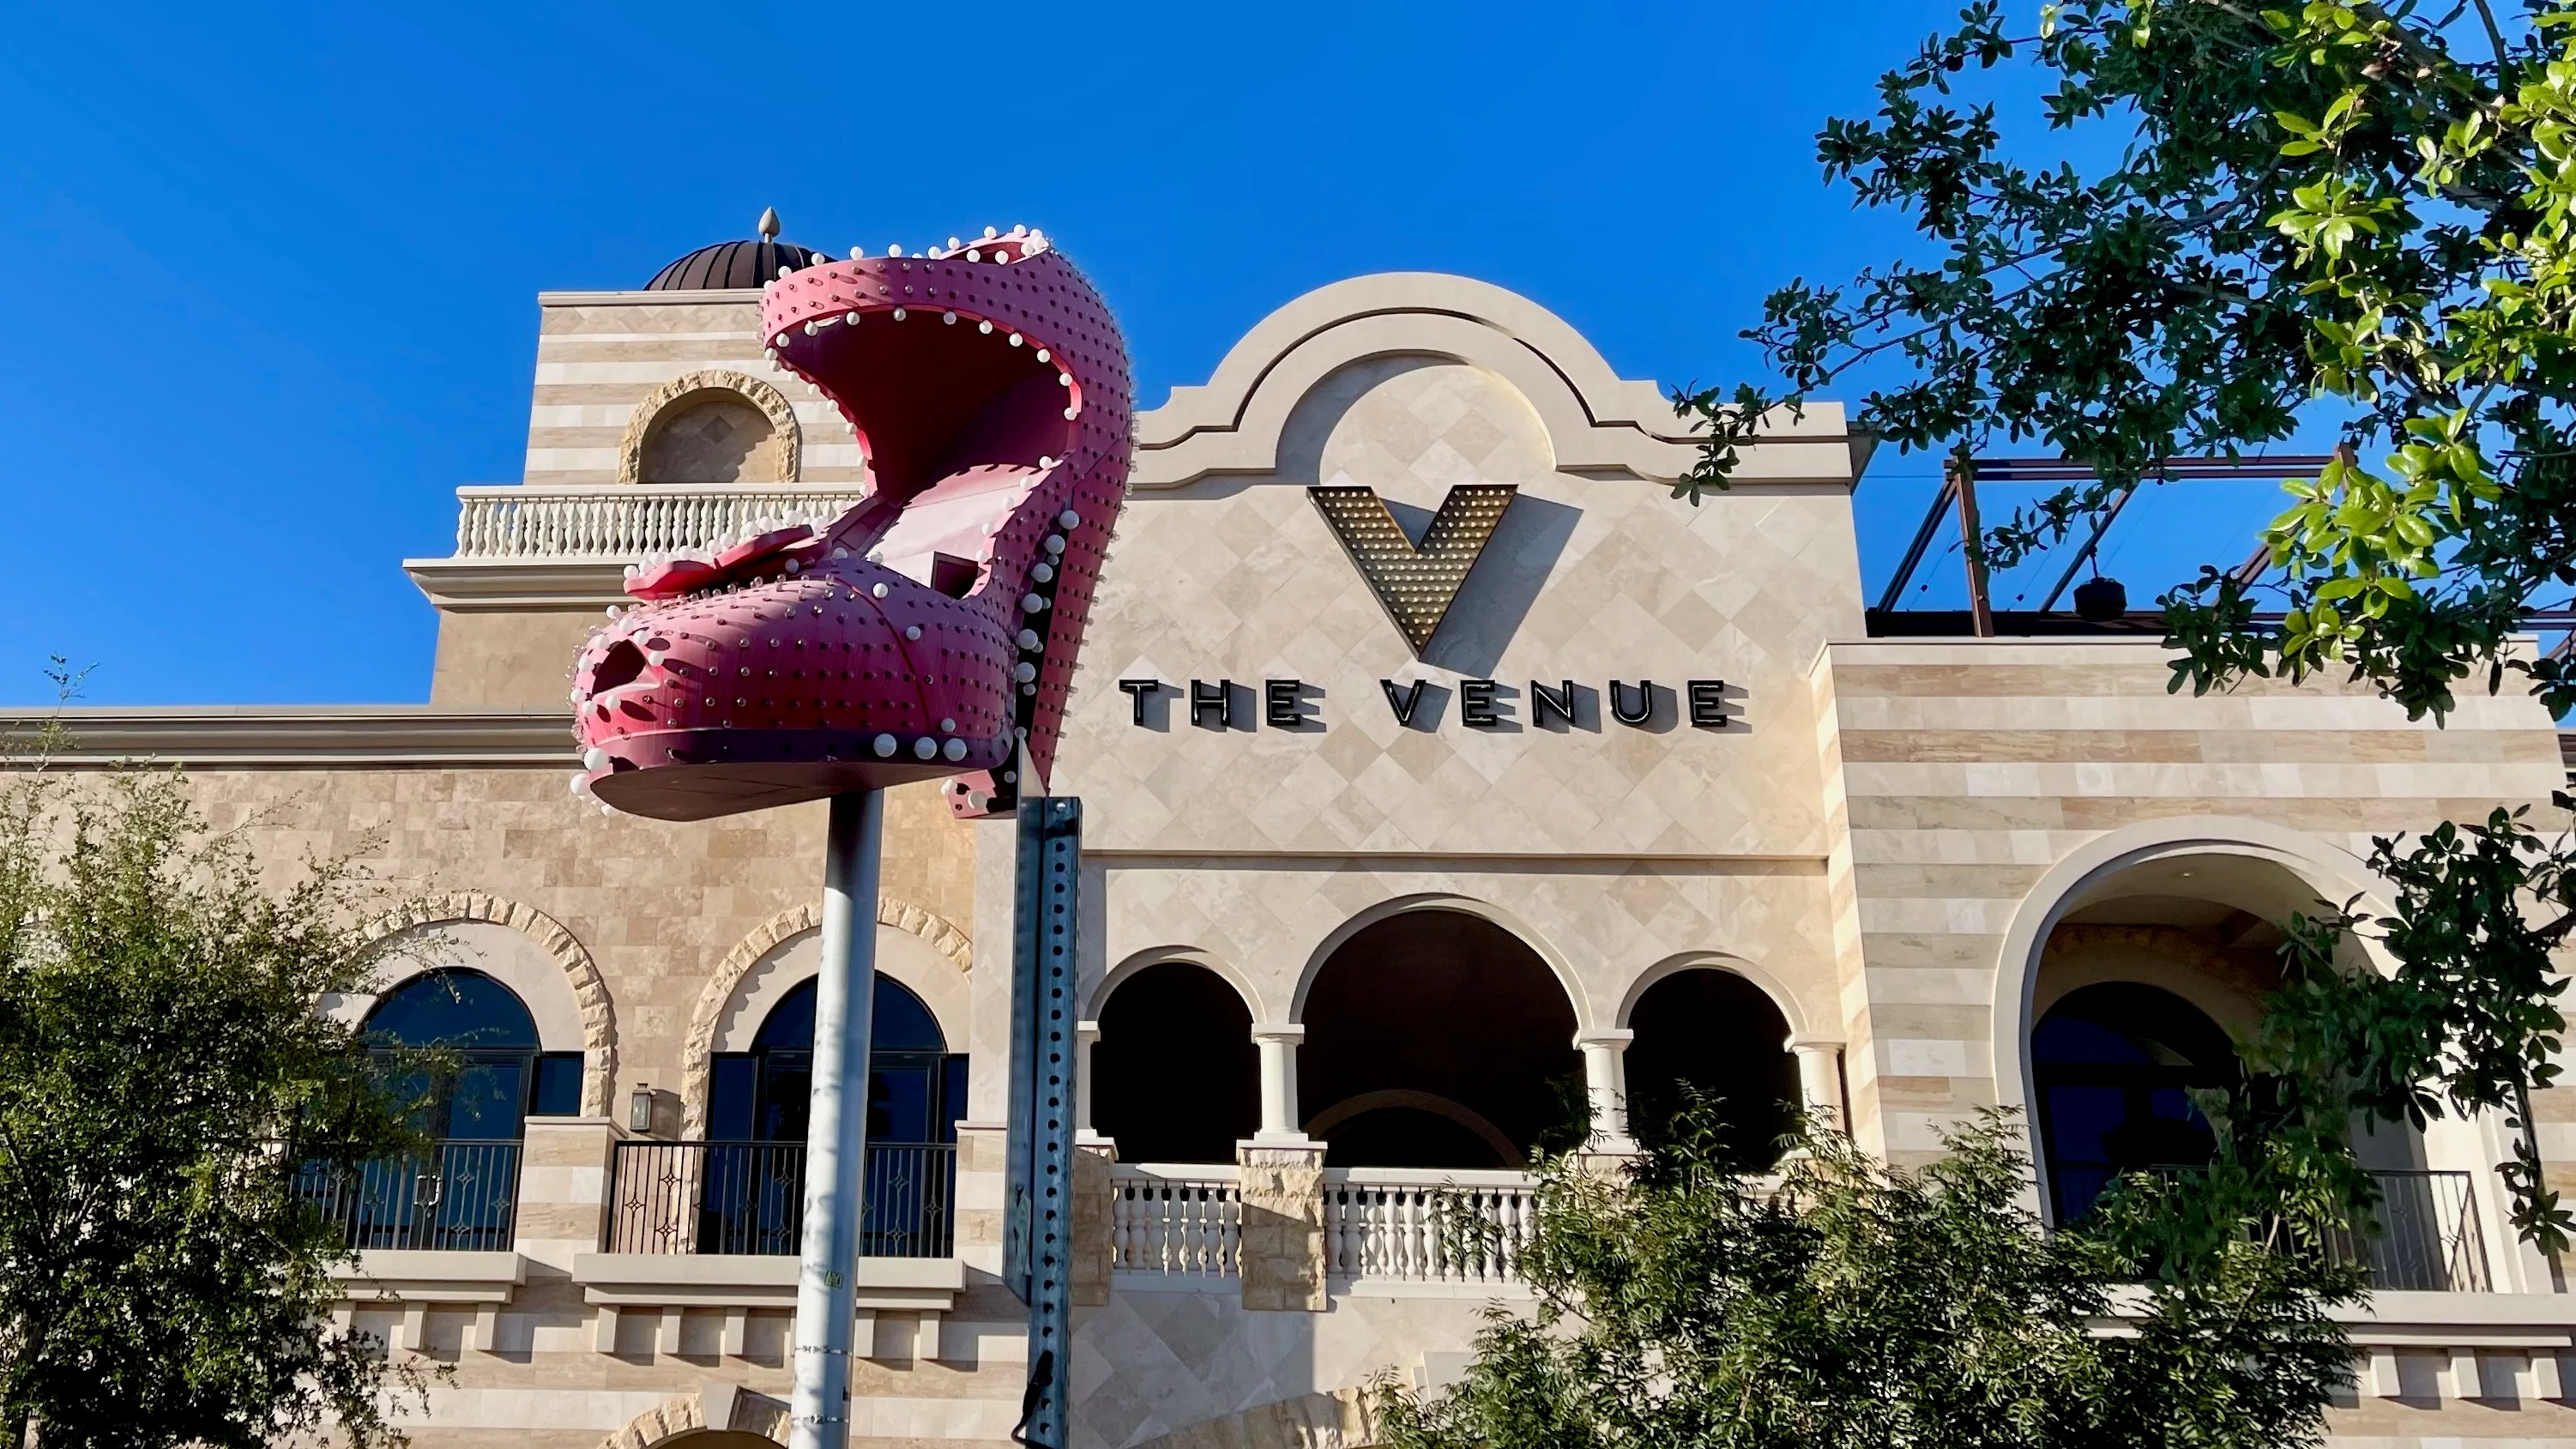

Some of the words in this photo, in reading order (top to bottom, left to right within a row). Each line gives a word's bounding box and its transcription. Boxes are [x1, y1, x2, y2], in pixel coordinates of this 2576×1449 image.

[1306, 485, 1519, 661] V
[1119, 679, 1301, 727] THE
[1379, 679, 1728, 728] VENUE
